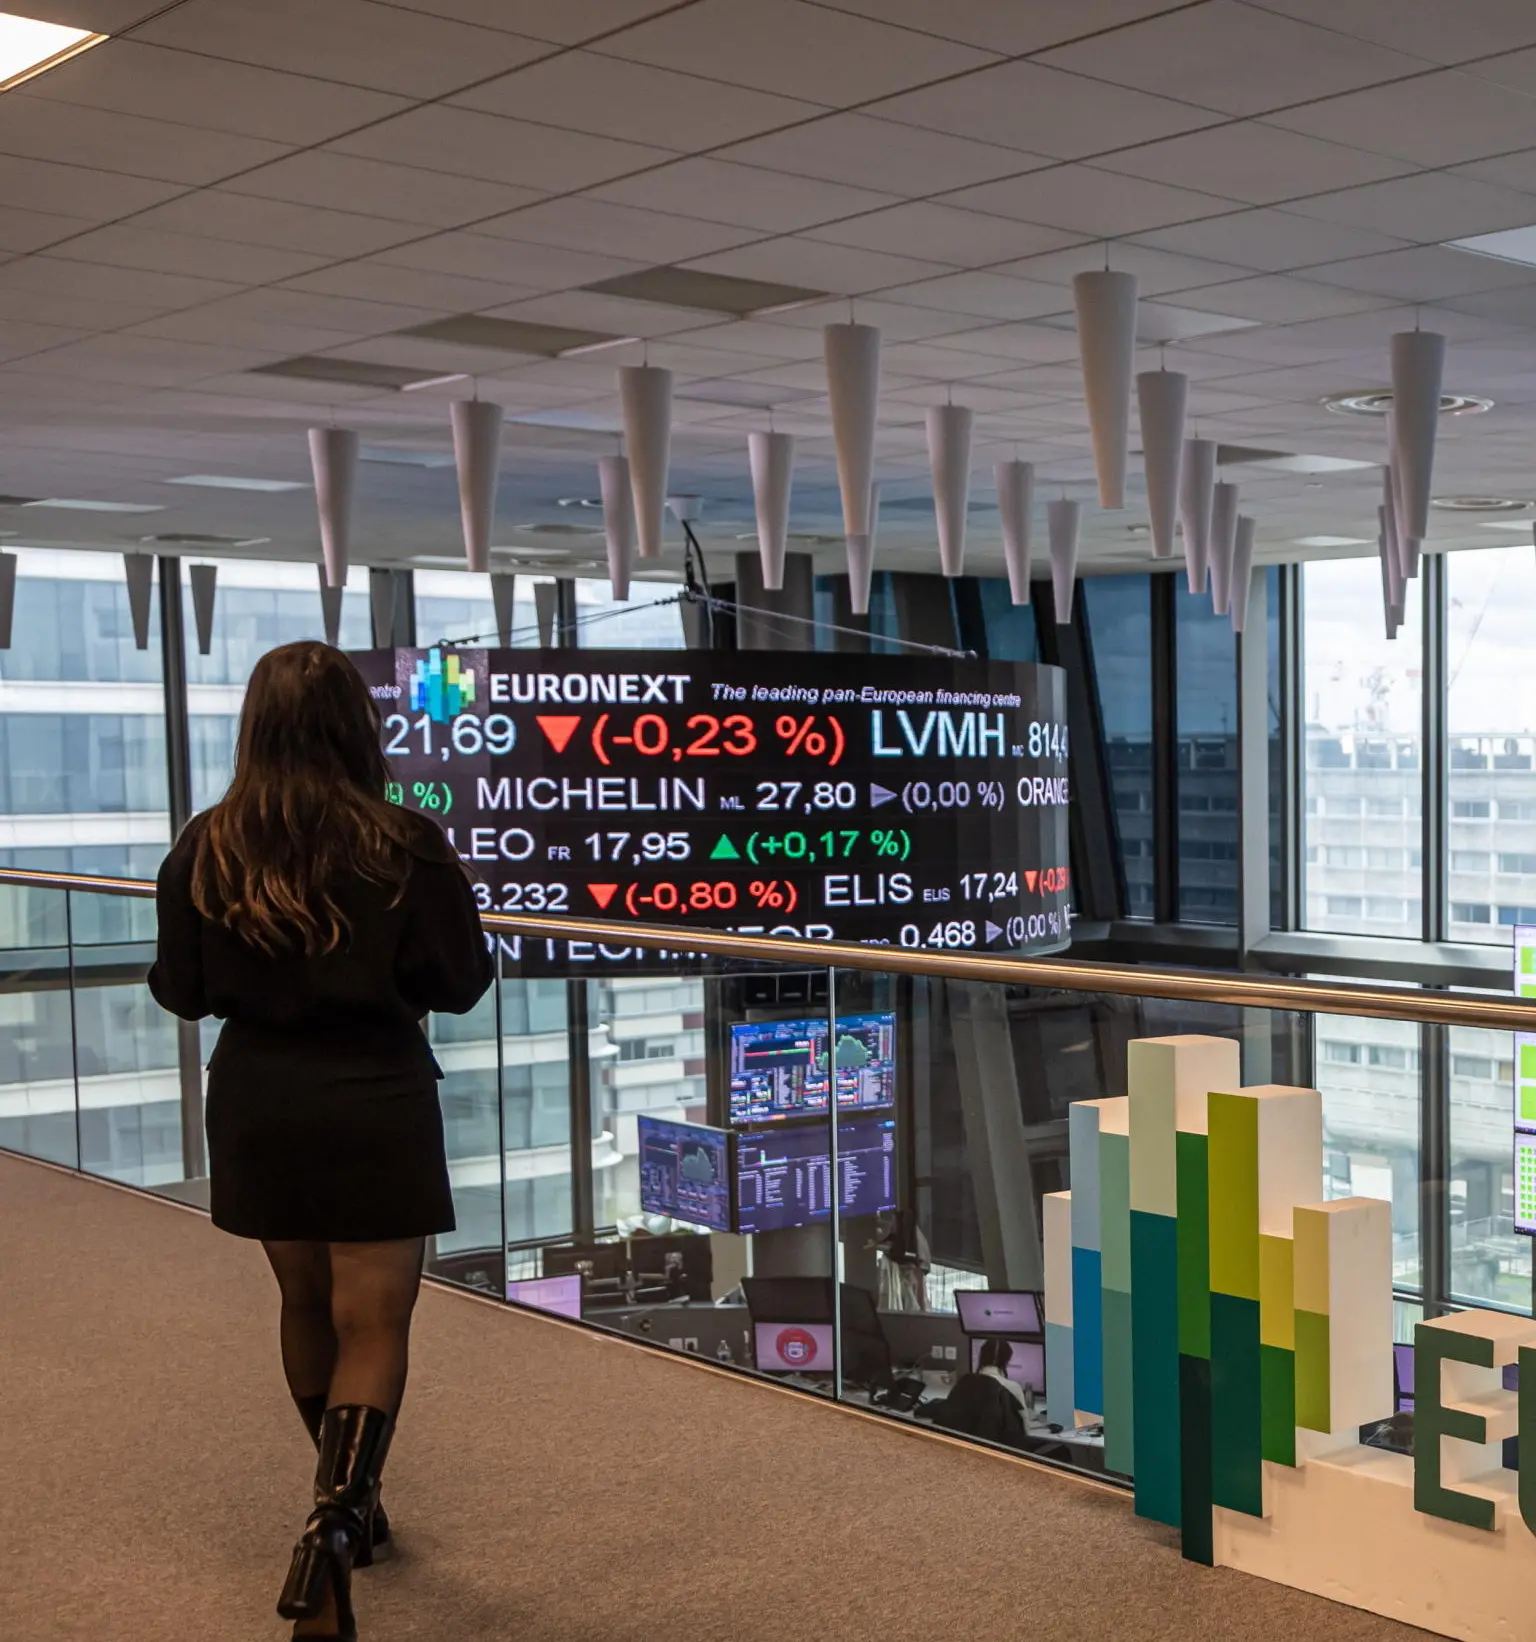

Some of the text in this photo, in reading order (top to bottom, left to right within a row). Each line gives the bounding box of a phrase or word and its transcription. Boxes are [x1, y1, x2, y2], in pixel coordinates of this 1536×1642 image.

[369, 682, 403, 700] entre
[490, 673, 691, 704] EURONEXT
[711, 683, 747, 701] The
[751, 684, 820, 705] leading
[821, 686, 934, 706] pan-European
[935, 688, 992, 709] financing
[384, 711, 516, 762] 21,69
[591, 713, 758, 766] (-0,23
[775, 715, 845, 767] %)
[871, 709, 1006, 758] LVMH
[1028, 721, 1068, 764] 814,4
[476, 776, 705, 811] MICHELIN
[719, 796, 746, 811] ML
[756, 781, 857, 815] 27,80
[902, 781, 971, 814] (0,00
[977, 781, 1005, 812] %)
[447, 827, 911, 866] LEO FR 17,95 (+0,17 %)
[625, 881, 737, 916] (-0,80
[748, 880, 798, 913] %)
[824, 872, 914, 907] ELIS
[923, 887, 951, 902] ELIS
[959, 871, 1019, 903] 17,24
